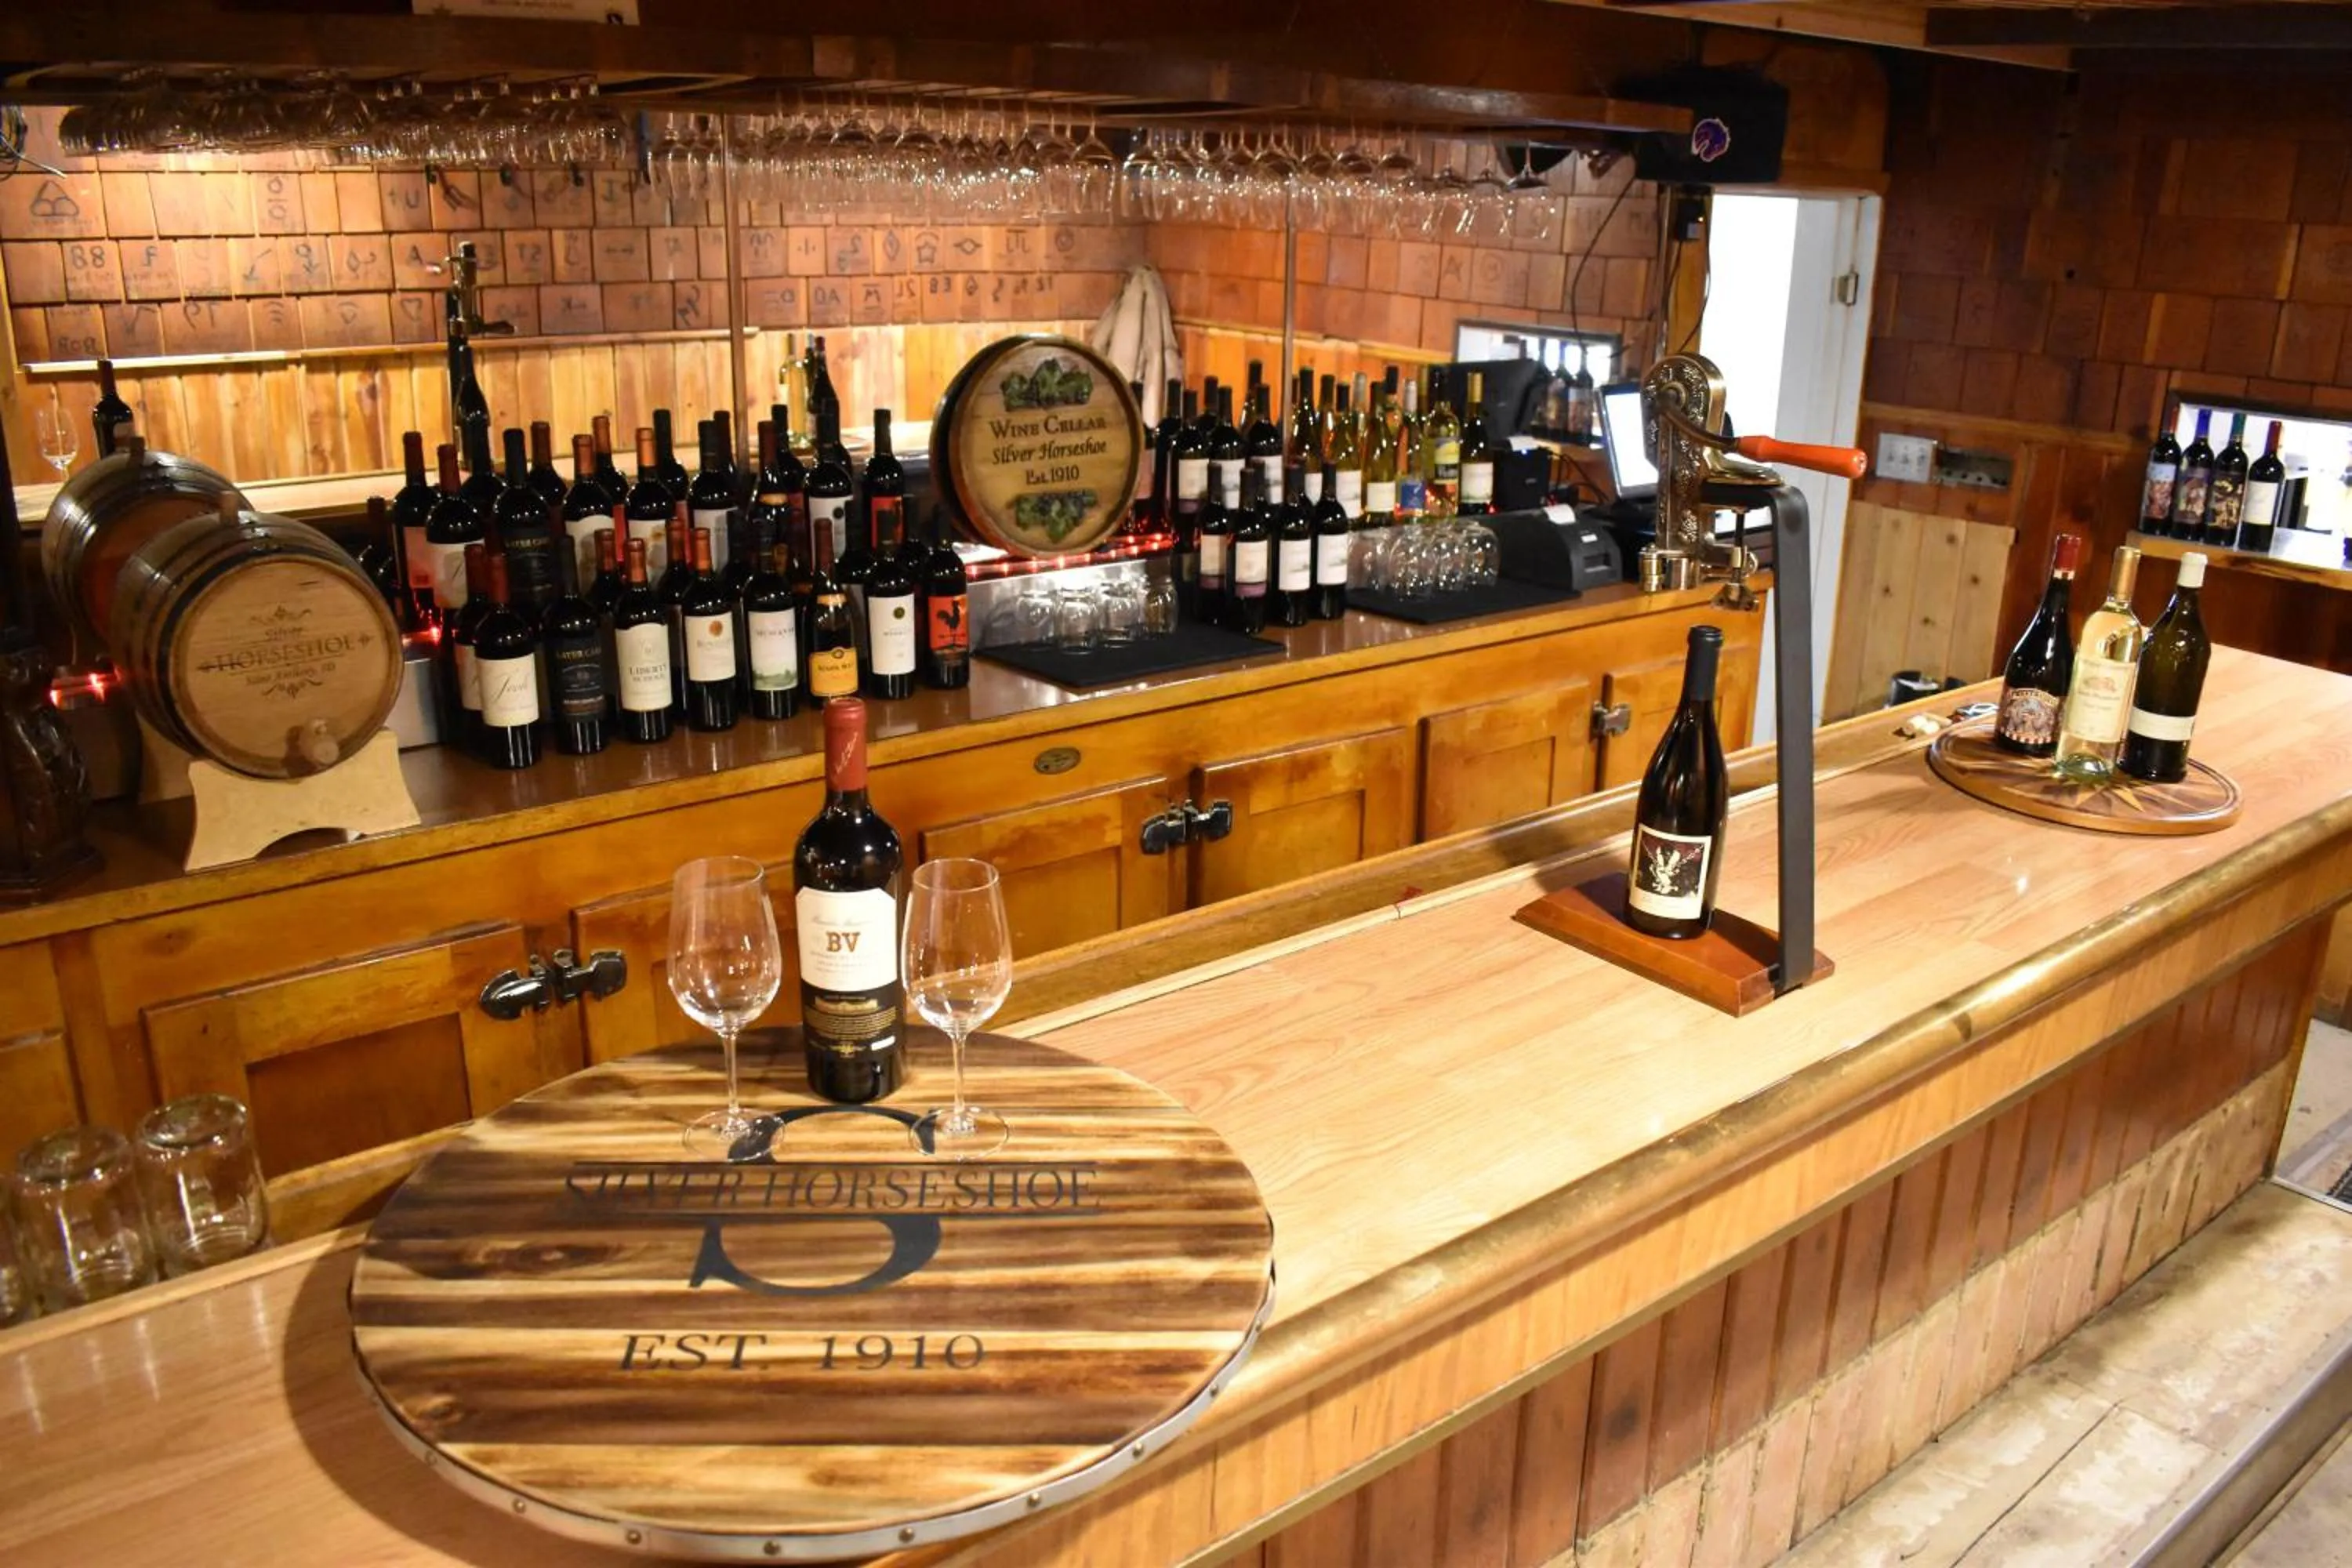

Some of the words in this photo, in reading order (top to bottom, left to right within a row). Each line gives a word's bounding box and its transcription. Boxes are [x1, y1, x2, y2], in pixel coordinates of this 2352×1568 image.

[992, 444, 1036, 465] Silver
[1037, 436, 1107, 462] Horseshoe
[1051, 465, 1080, 483] 1910
[826, 931, 862, 953] BV
[764, 1168, 1101, 1209] HORSESHOE
[814, 1334, 988, 1371] 1910
